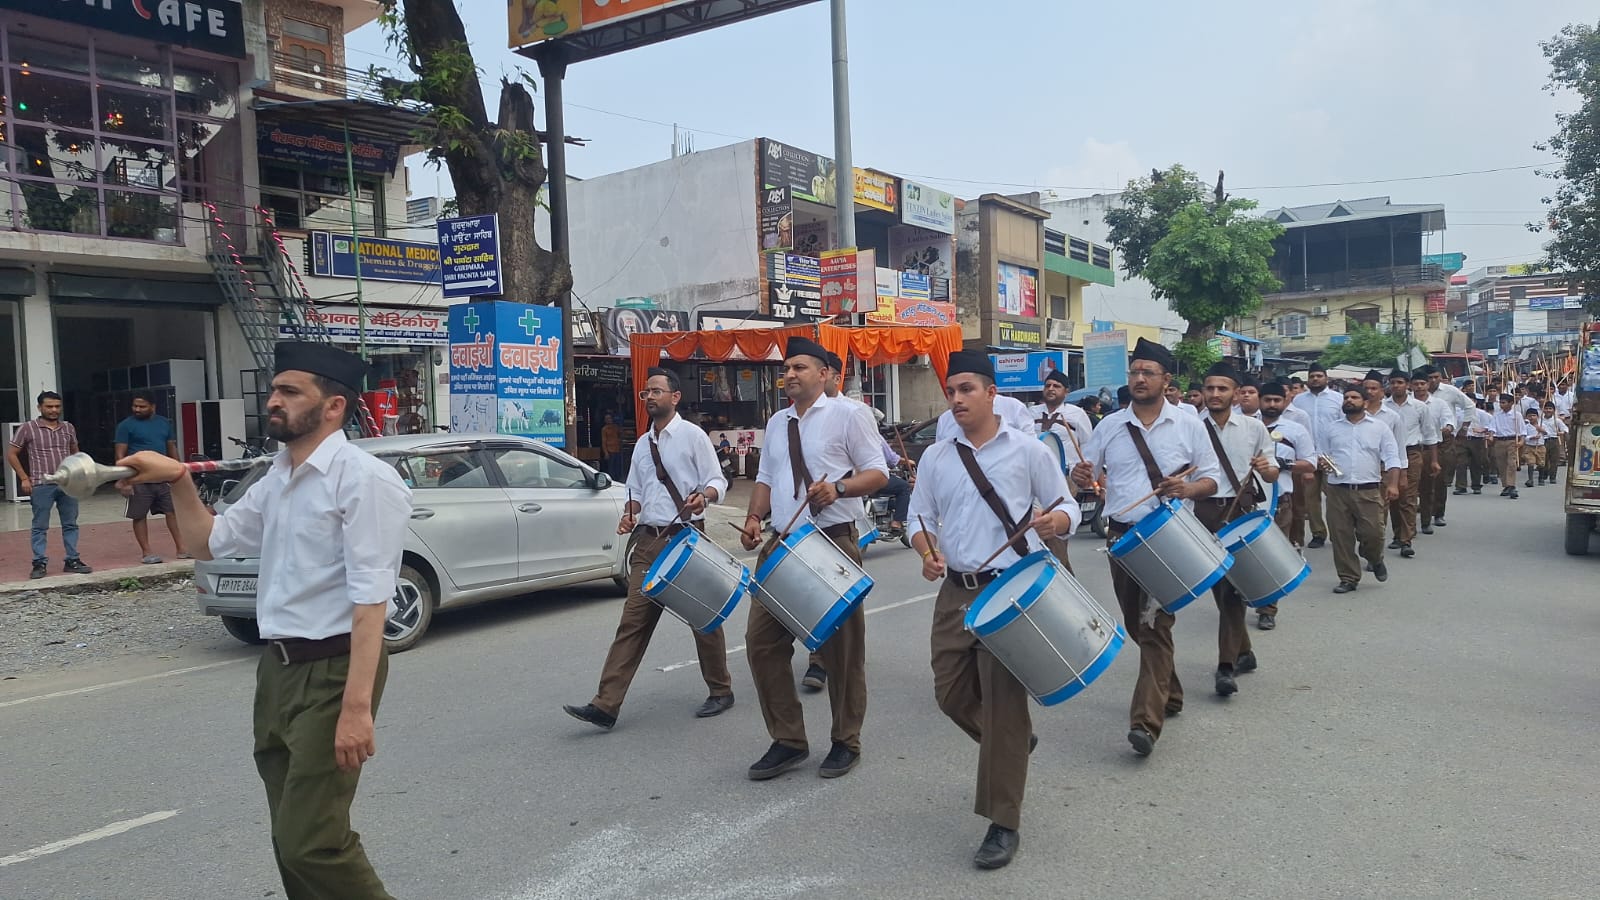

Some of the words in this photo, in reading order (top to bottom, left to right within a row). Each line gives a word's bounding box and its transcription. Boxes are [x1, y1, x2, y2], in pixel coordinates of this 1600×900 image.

[132, 0, 227, 37] CAFE
[350, 241, 403, 258] NATIONAL
[772, 303, 796, 319] TAJ
